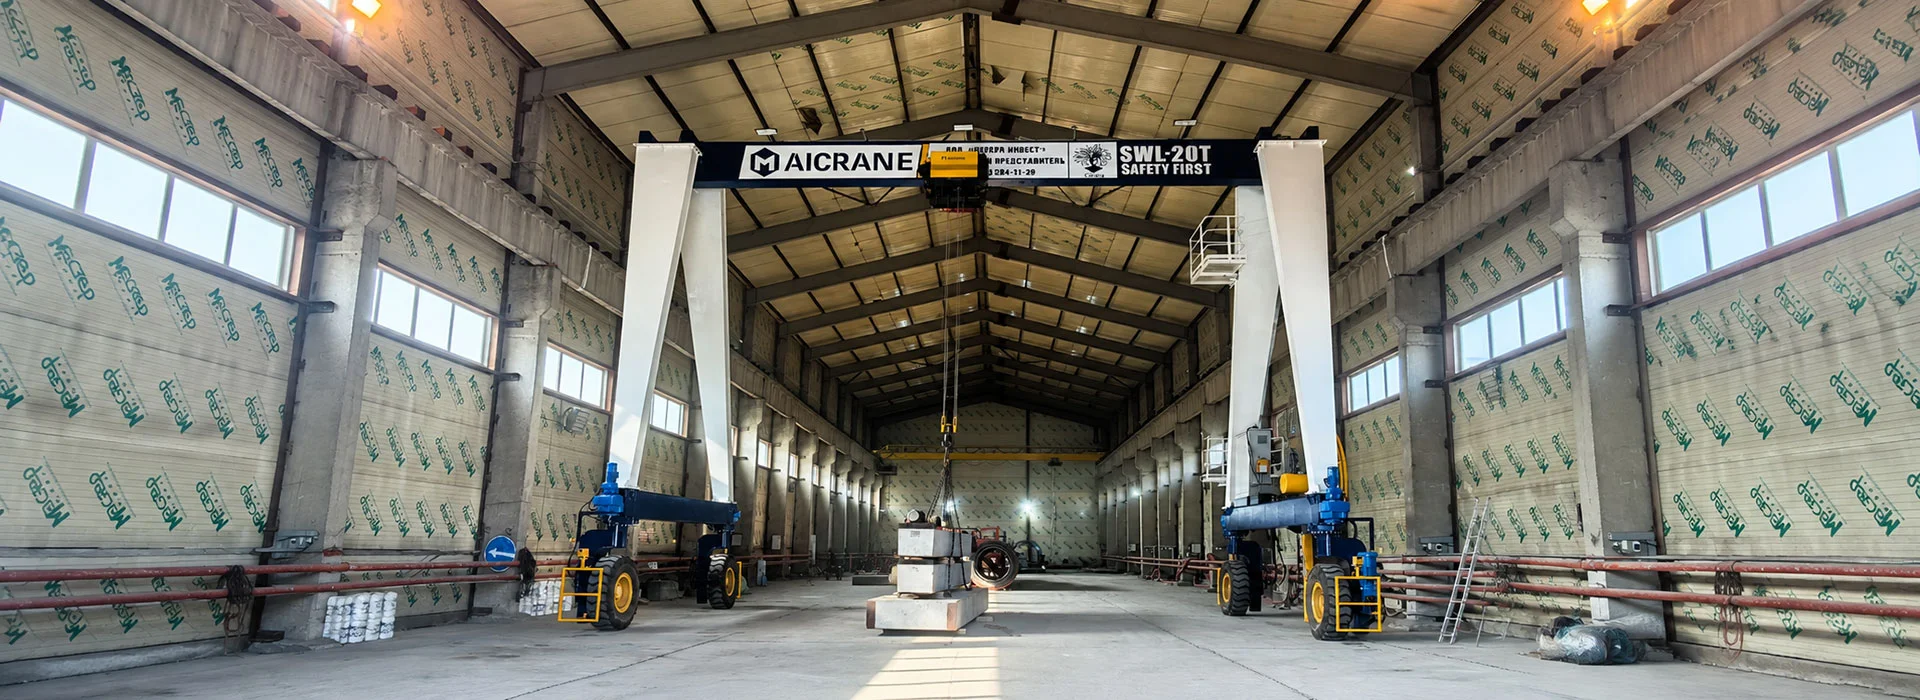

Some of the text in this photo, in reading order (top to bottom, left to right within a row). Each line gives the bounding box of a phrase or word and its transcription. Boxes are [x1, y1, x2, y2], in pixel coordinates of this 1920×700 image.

[784, 152, 913, 172] AICRANE
[1120, 145, 1211, 163] SWL-20T
[1121, 163, 1212, 175] SAFETY FIRST
